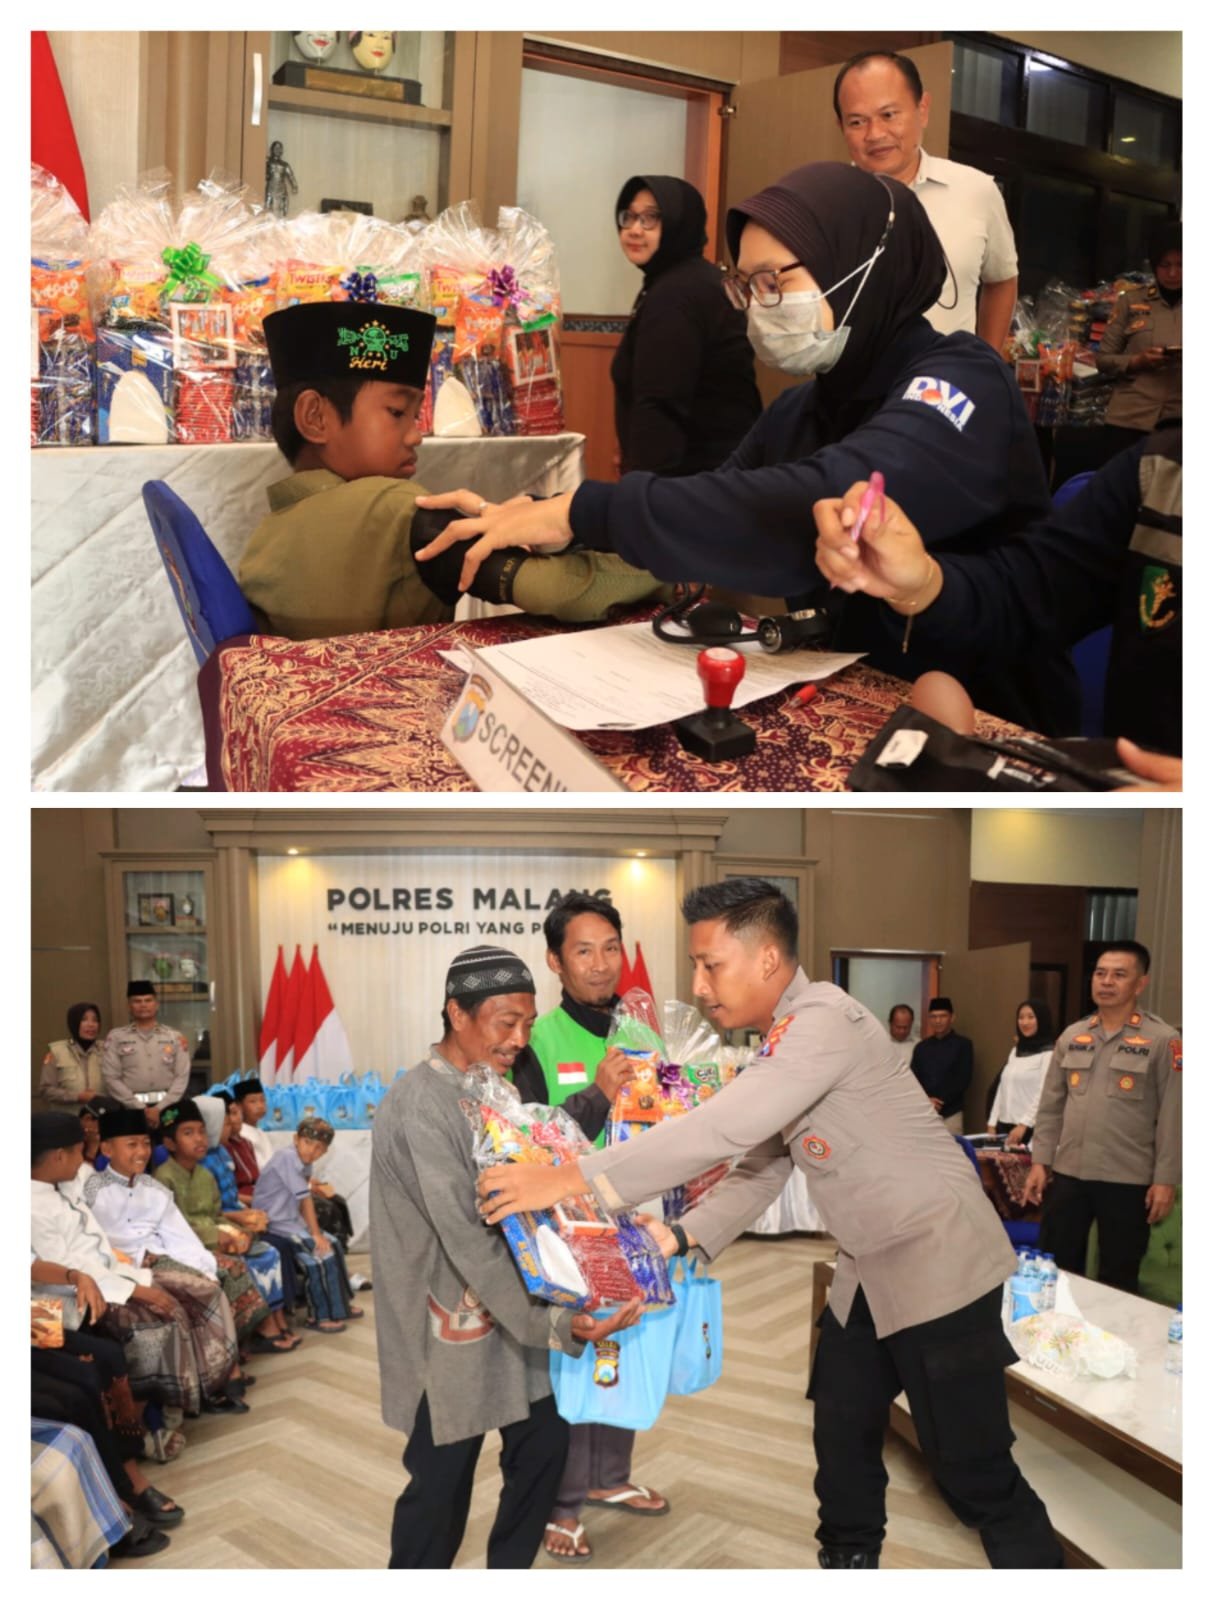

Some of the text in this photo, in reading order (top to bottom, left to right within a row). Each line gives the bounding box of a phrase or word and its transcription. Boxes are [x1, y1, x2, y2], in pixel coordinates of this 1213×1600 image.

[478, 711, 568, 792] SCREEN
[327, 887, 612, 911] POLRES MALAG
[418, 921, 470, 935] POLRI
[476, 922, 525, 935] YANG
